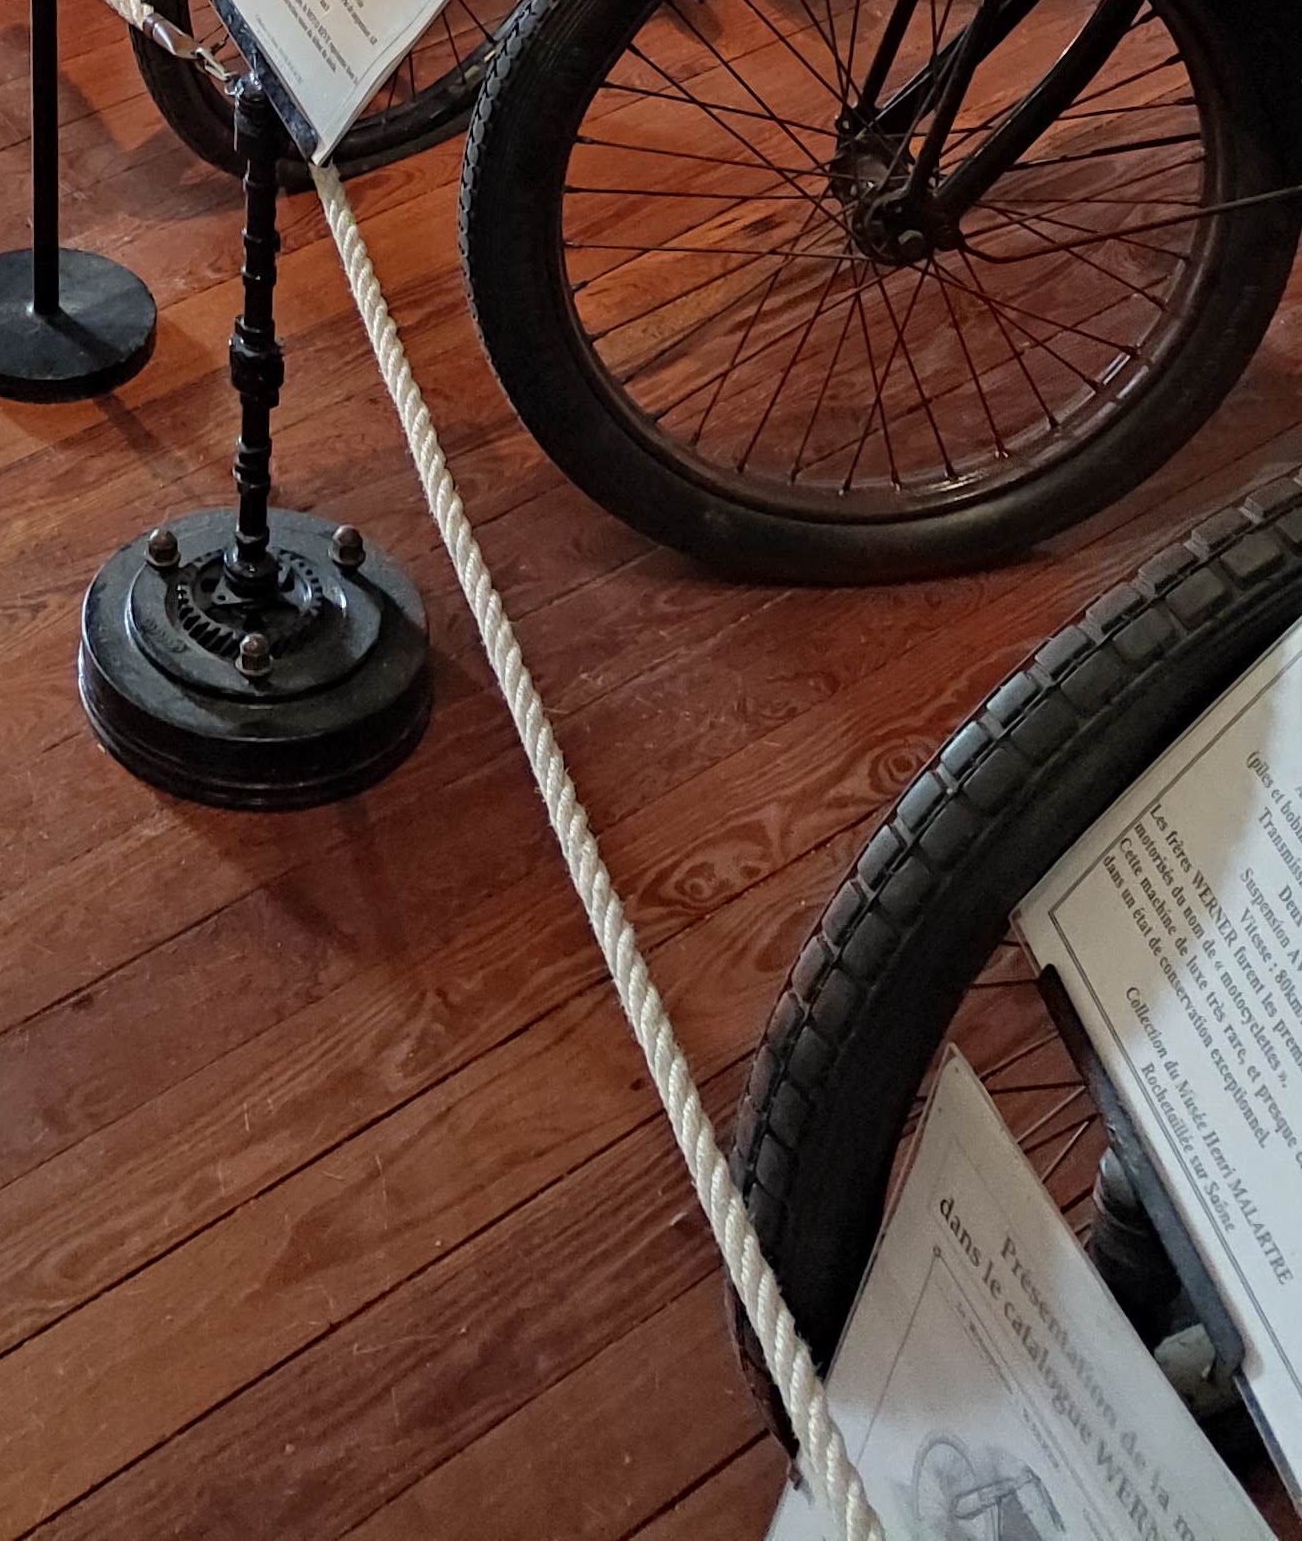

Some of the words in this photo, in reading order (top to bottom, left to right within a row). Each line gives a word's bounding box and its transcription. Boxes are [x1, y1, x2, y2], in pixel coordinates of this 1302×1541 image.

[1243, 746, 1276, 795] (piles
[1270, 784, 1285, 805] et
[1101, 851, 1127, 890] dans
[1120, 887, 1136, 909] un
[1131, 903, 1155, 938] état
[1147, 932, 1165, 957] de
[1157, 951, 1216, 1049] conservation
[1117, 834, 1146, 878] Cette
[1139, 872, 1180, 937] machine
[1174, 933, 1191, 958] de
[1185, 954, 1210, 992] luxe
[1205, 988, 1228, 1023] très
[1220, 1021, 1250, 1067] rare,
[1245, 1060, 1261, 1083] et
[1253, 1081, 1298, 1153] presque
[1133, 817, 1177, 887] motorisés
[1170, 881, 1188, 907] du
[1182, 905, 1205, 940] nom
[1201, 934, 1219, 960] de
[1217, 966, 1284, 1075] motocyclettes
[1149, 801, 1171, 832] Les
[1165, 828, 1195, 874] frères
[1189, 868, 1239, 949] WERNER
[1233, 944, 1266, 996] furent
[1260, 991, 1280, 1019] les
[1237, 864, 1292, 953] Suspension
[1237, 906, 1274, 965] Vitesse
[1123, 982, 1172, 1060] Collection
[1163, 1054, 1182, 1082] du
[1173, 1073, 1211, 1133] Musée
[1200, 1124, 1237, 1182] Henri
[1224, 1172, 1296, 1290] MALARTRE
[1138, 1058, 1198, 1156] Rochetaillée
[1188, 1152, 1209, 1183] sur
[1202, 1177, 1239, 1234] Saône
[937, 1190, 985, 1270] dans
[981, 1259, 1006, 1302] le
[996, 1293, 1096, 1454] catalogue
[998, 1234, 1122, 1432] Présentation
[1118, 1423, 1149, 1477] de
[1147, 1469, 1174, 1515] la
